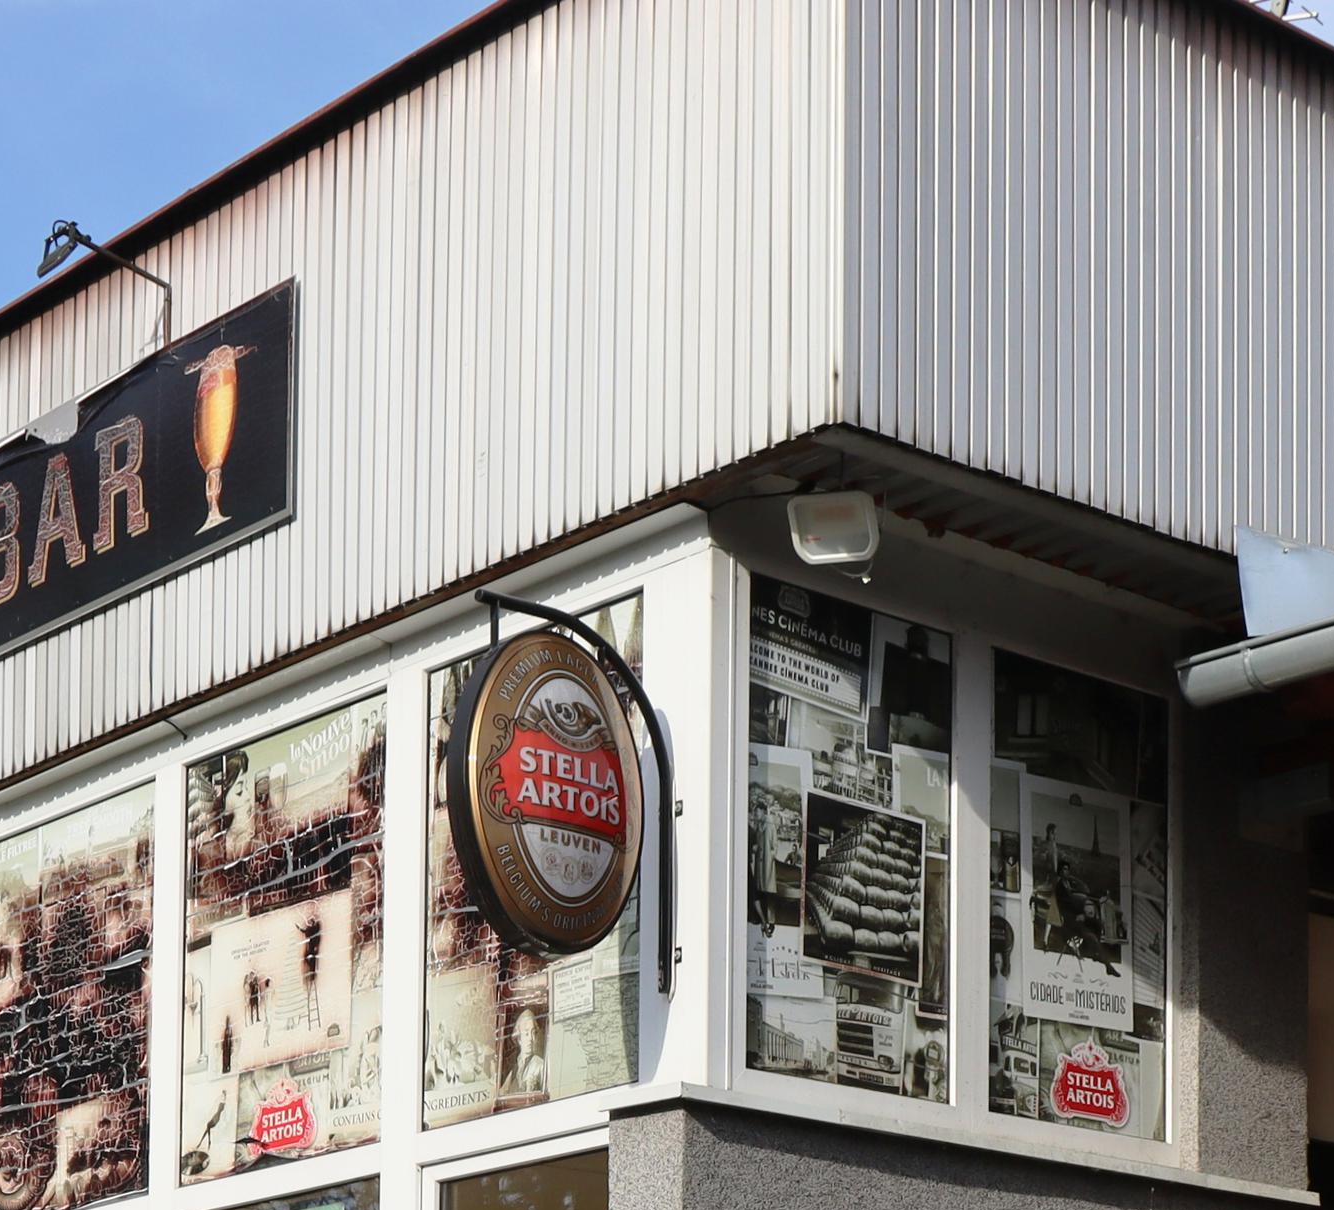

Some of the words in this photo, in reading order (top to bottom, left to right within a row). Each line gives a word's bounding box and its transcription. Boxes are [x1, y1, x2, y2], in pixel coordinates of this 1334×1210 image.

[829, 634, 862, 658] CLUB
[499, 649, 552, 701] PREMIUM
[777, 651, 787, 665] TO
[789, 656, 802, 670] THE
[804, 661, 829, 680] WORLD
[831, 672, 840, 684] OF
[811, 678, 829, 693] CLUB
[519, 746, 619, 795] STELLA
[517, 778, 621, 825] ARTOIS
[540, 827, 602, 855] LEUVEN
[497, 844, 551, 921] BELGIUM'S
[1030, 981, 1065, 1005] CIDADE
[1075, 988, 1127, 1015] MISTÉRIOS
[1066, 1070, 1114, 1093] STELLA
[1066, 1088, 1115, 1109] ARTOIS
[261, 1107, 303, 1129] STELLA
[332, 1111, 375, 1127] CONTAINS
[261, 1122, 304, 1143] ARTOIS
